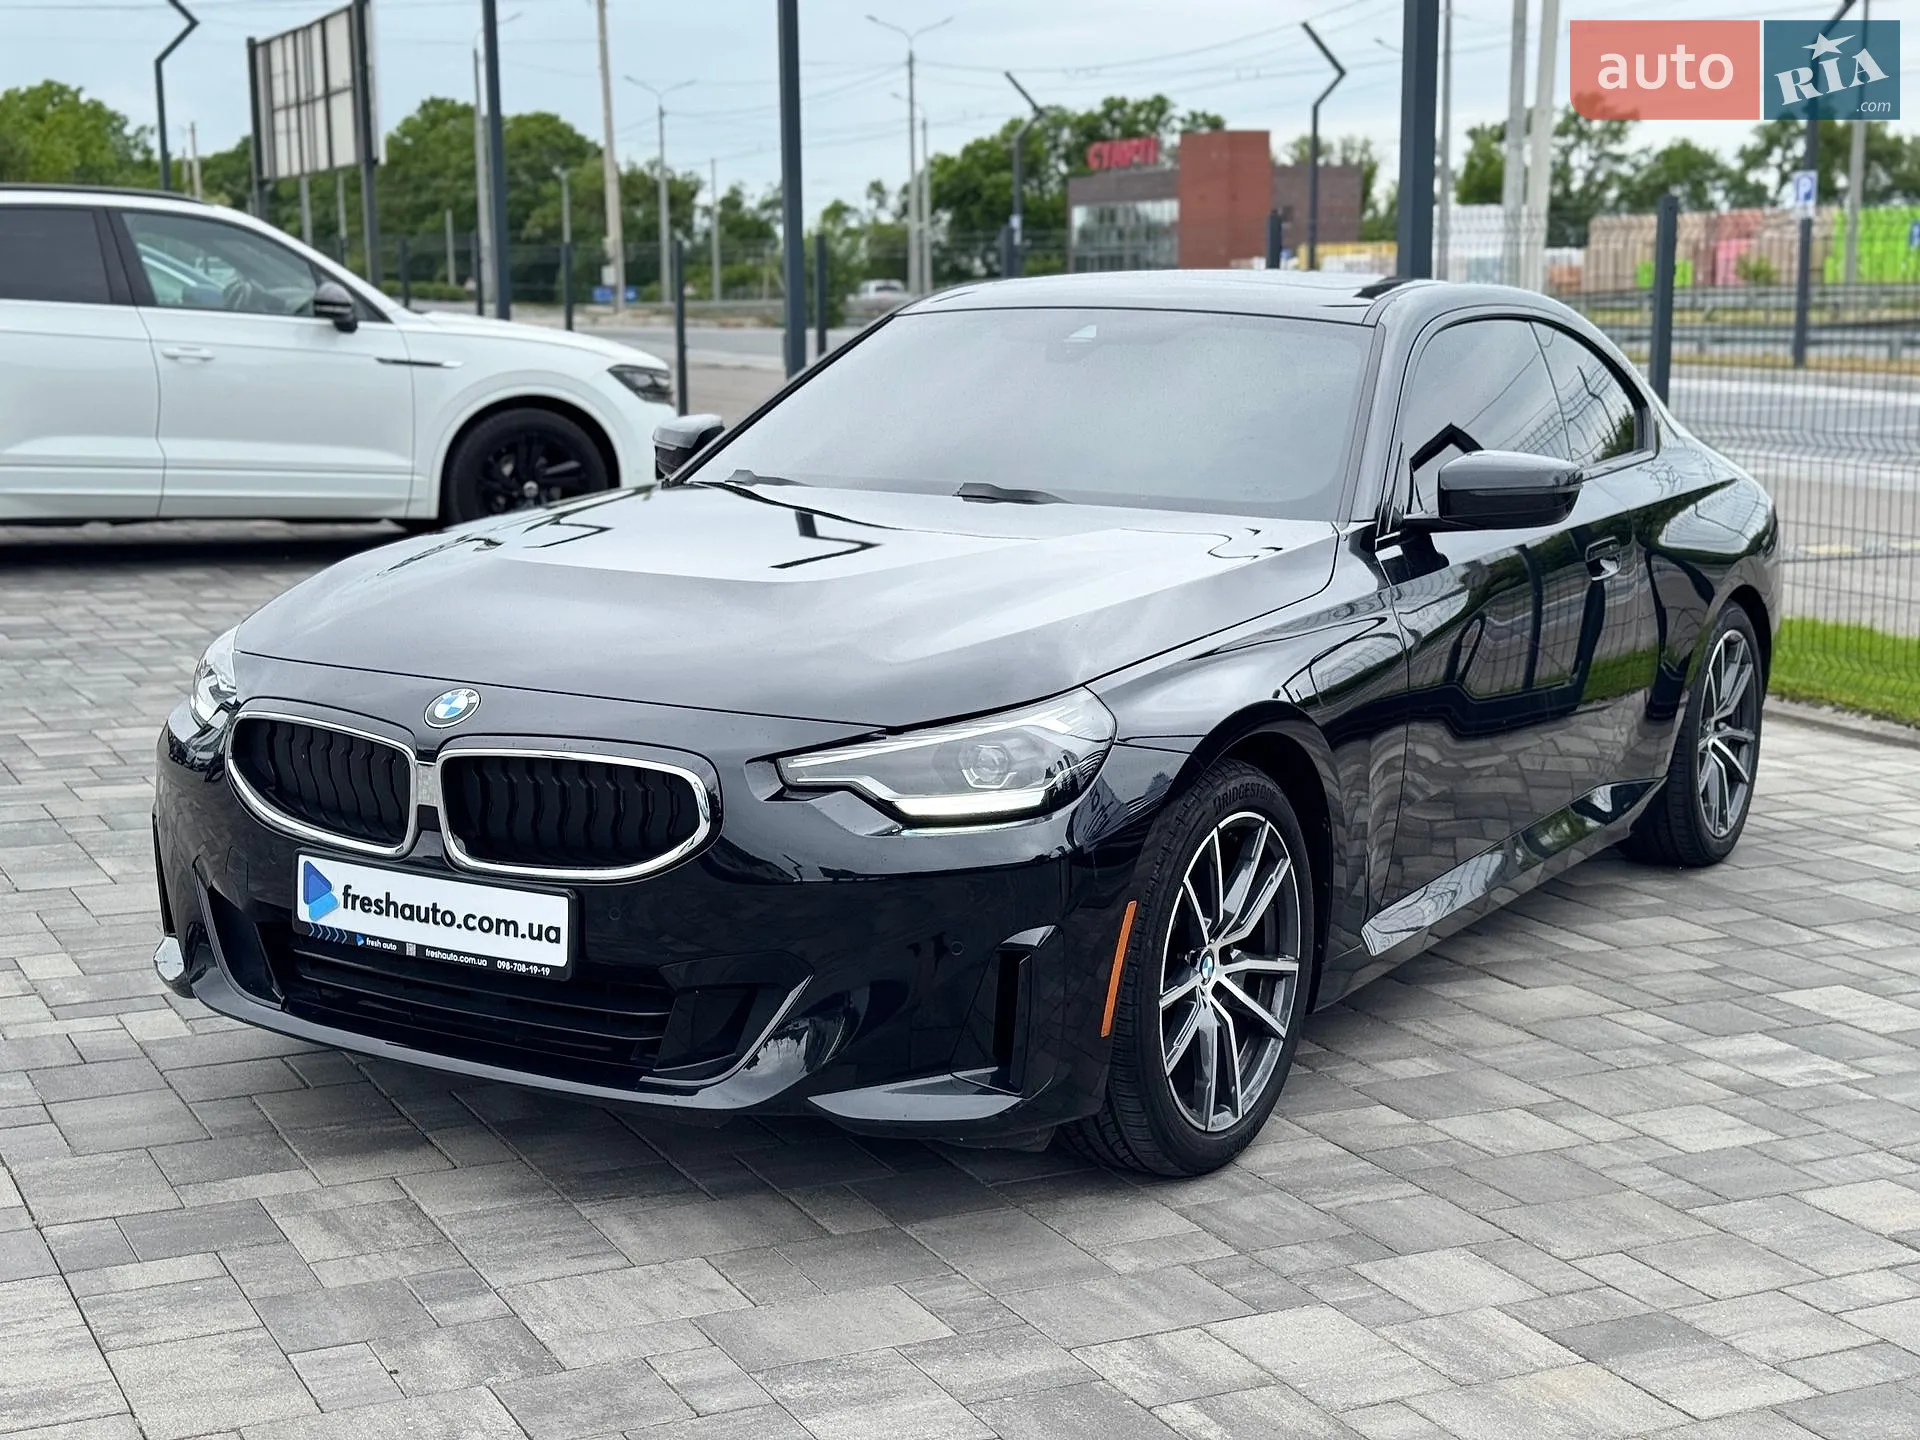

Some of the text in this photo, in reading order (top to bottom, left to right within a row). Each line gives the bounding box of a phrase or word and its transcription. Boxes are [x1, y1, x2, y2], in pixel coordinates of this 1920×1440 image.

[1799, 177, 1812, 200] P
[341, 884, 561, 944] freshauto.com.ua
[366, 937, 398, 952] fresh auto
[425, 948, 488, 967] freshauto.com.ua
[496, 960, 551, 977] 098-708-19-19
